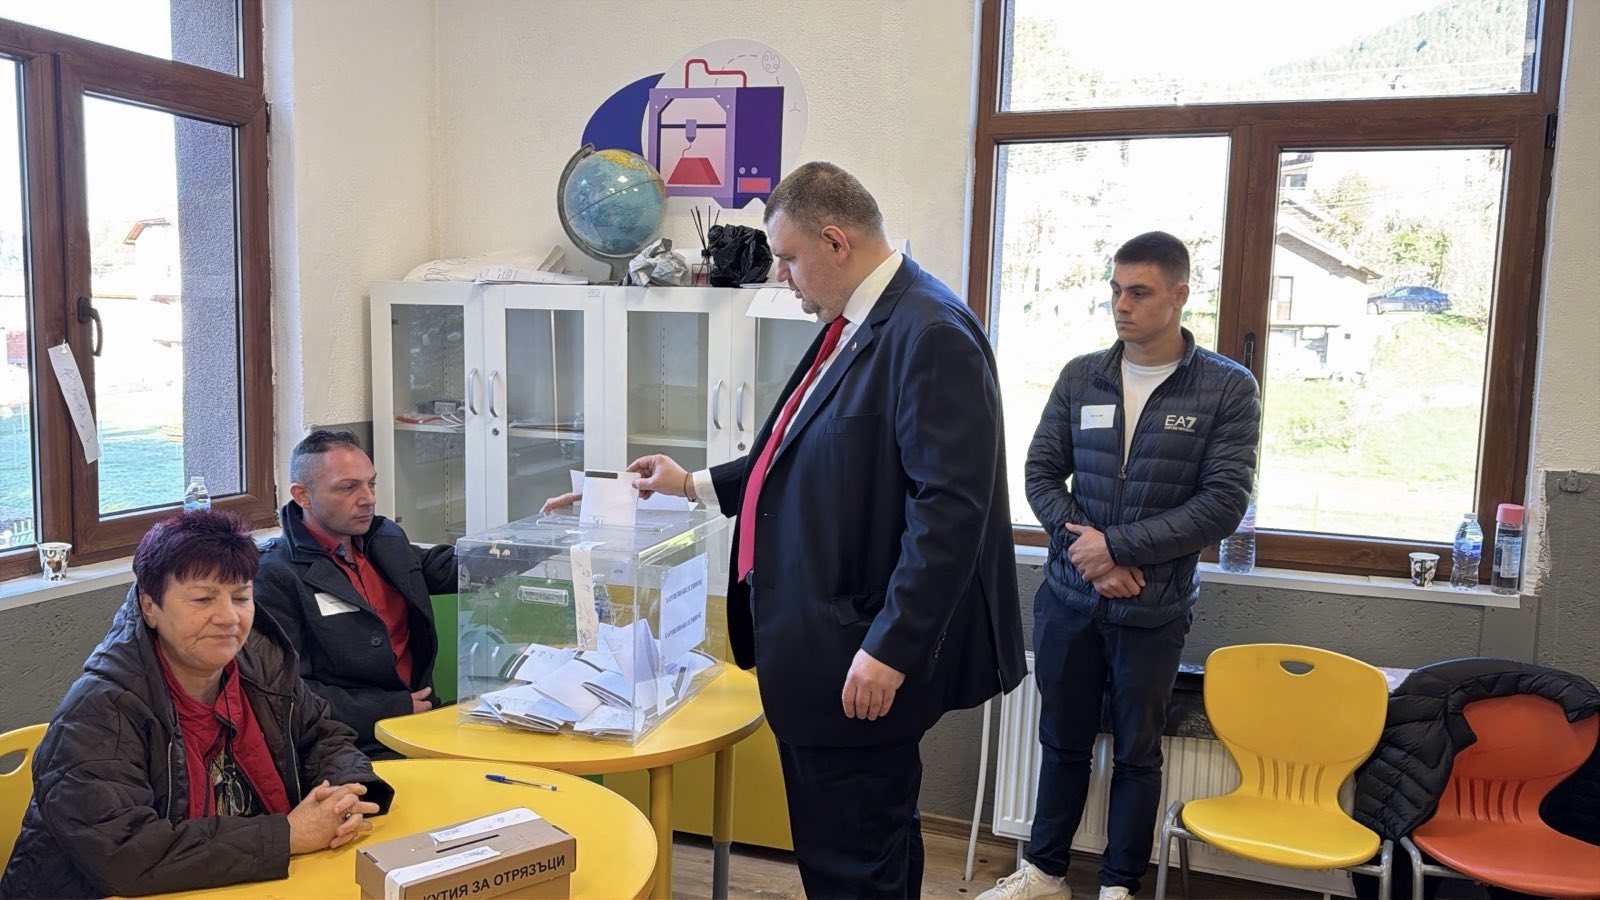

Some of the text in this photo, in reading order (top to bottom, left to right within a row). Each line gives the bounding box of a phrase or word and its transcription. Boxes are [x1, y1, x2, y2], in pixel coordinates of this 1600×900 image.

[1164, 414, 1198, 429] EA7
[472, 878, 490, 893] ЗА
[493, 854, 565, 886] ОТРЯЗЪЦИ
